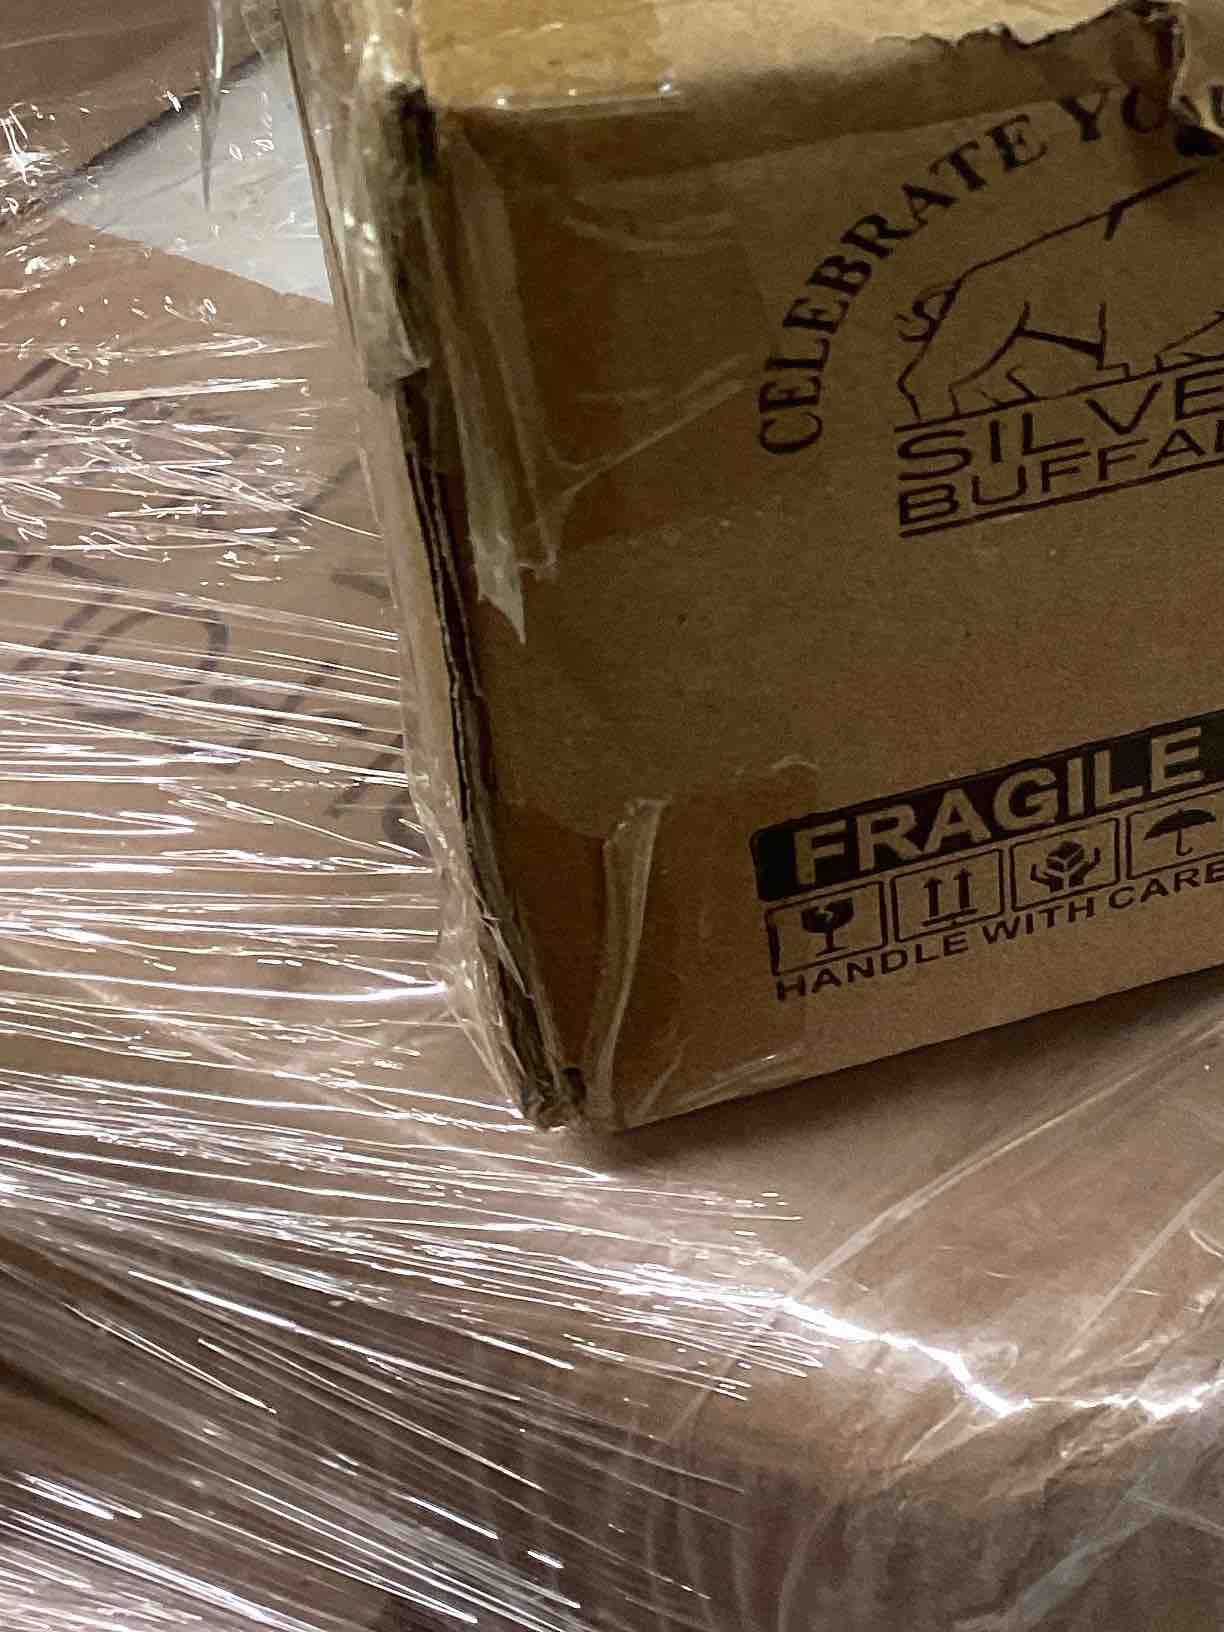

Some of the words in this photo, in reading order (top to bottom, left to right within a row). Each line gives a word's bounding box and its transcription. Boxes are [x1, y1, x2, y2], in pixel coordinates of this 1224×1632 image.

[759, 113, 1048, 455] CELEBRATE
[793, 724, 1203, 887] FRAGILE
[775, 931, 969, 1002] HANDLE
[981, 894, 1096, 946] WITH
